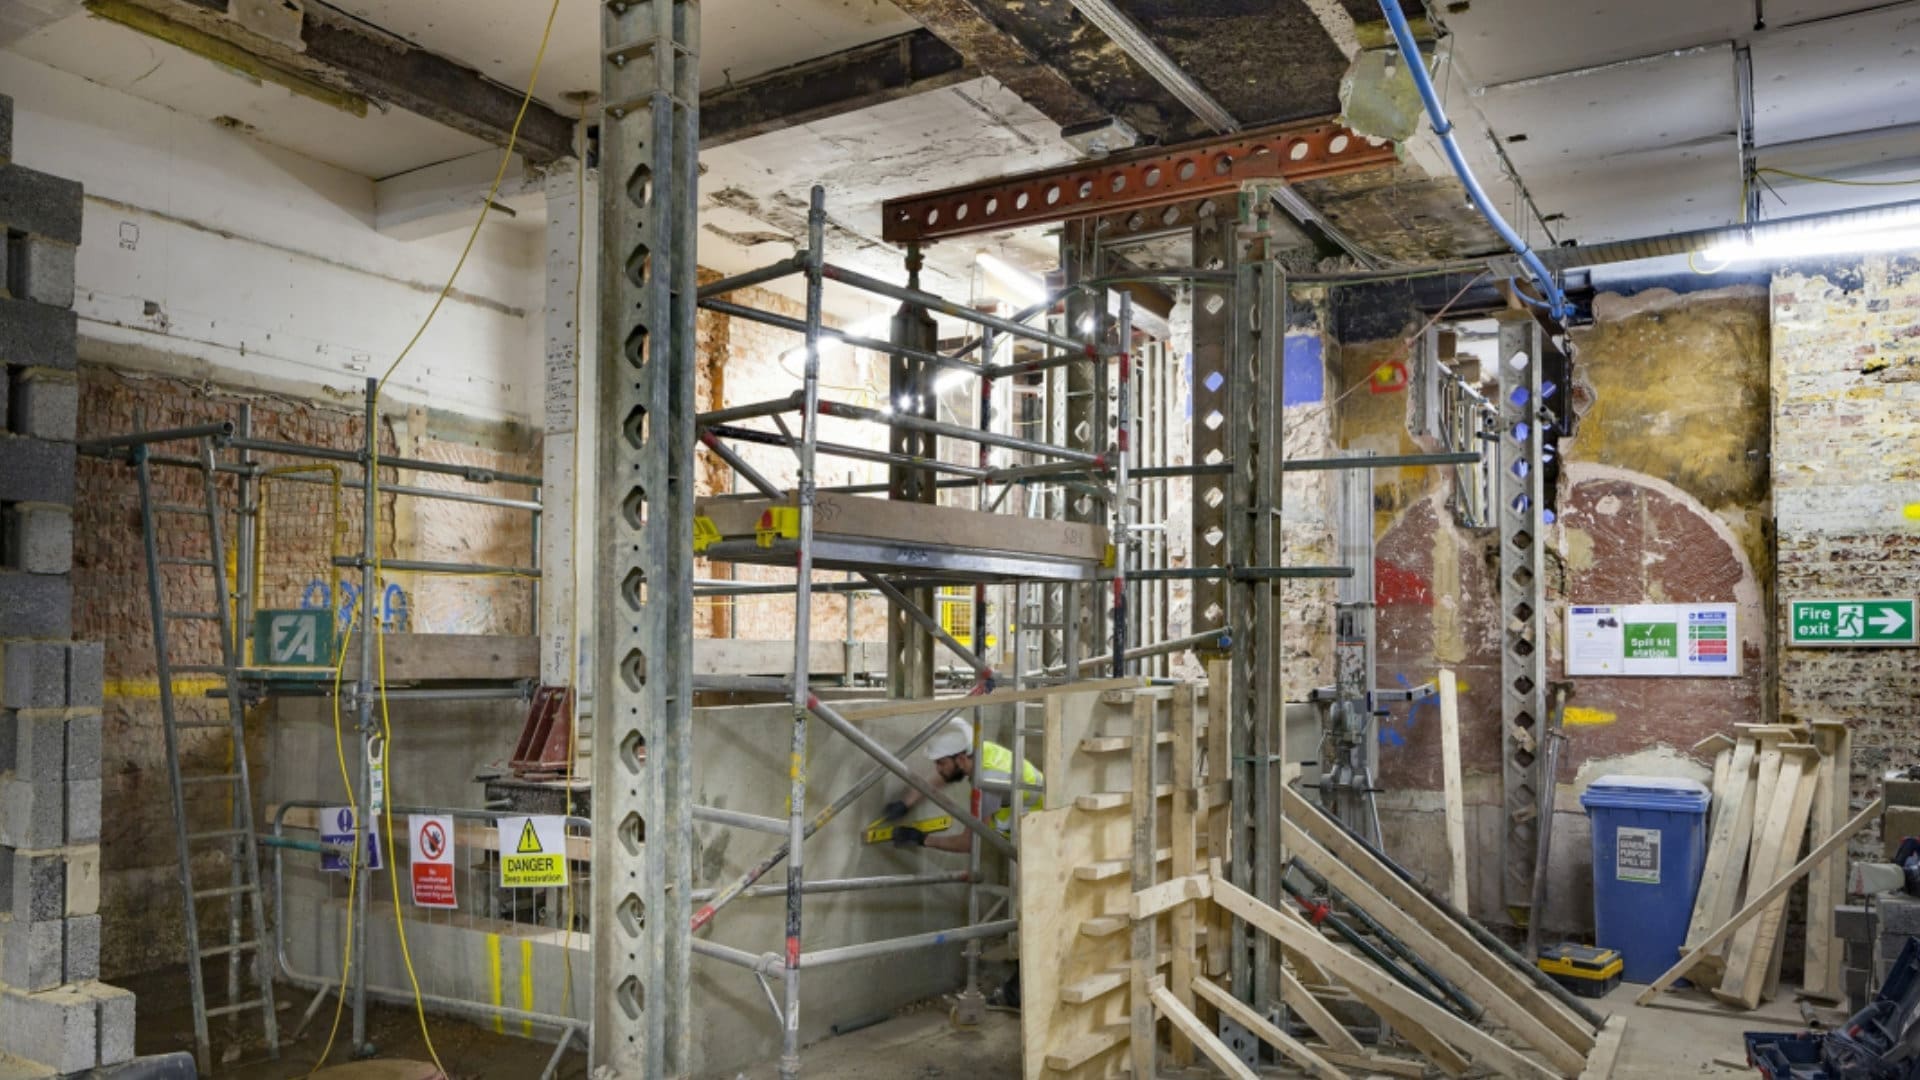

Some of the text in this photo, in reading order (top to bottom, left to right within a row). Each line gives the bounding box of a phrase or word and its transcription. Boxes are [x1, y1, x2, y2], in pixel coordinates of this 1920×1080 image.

[1799, 607, 1832, 620] Fire
[1798, 622, 1829, 636] exit
[1631, 638, 1671, 649] Spill kit
[1632, 648, 1670, 657] station
[508, 857, 554, 872] DANGER
